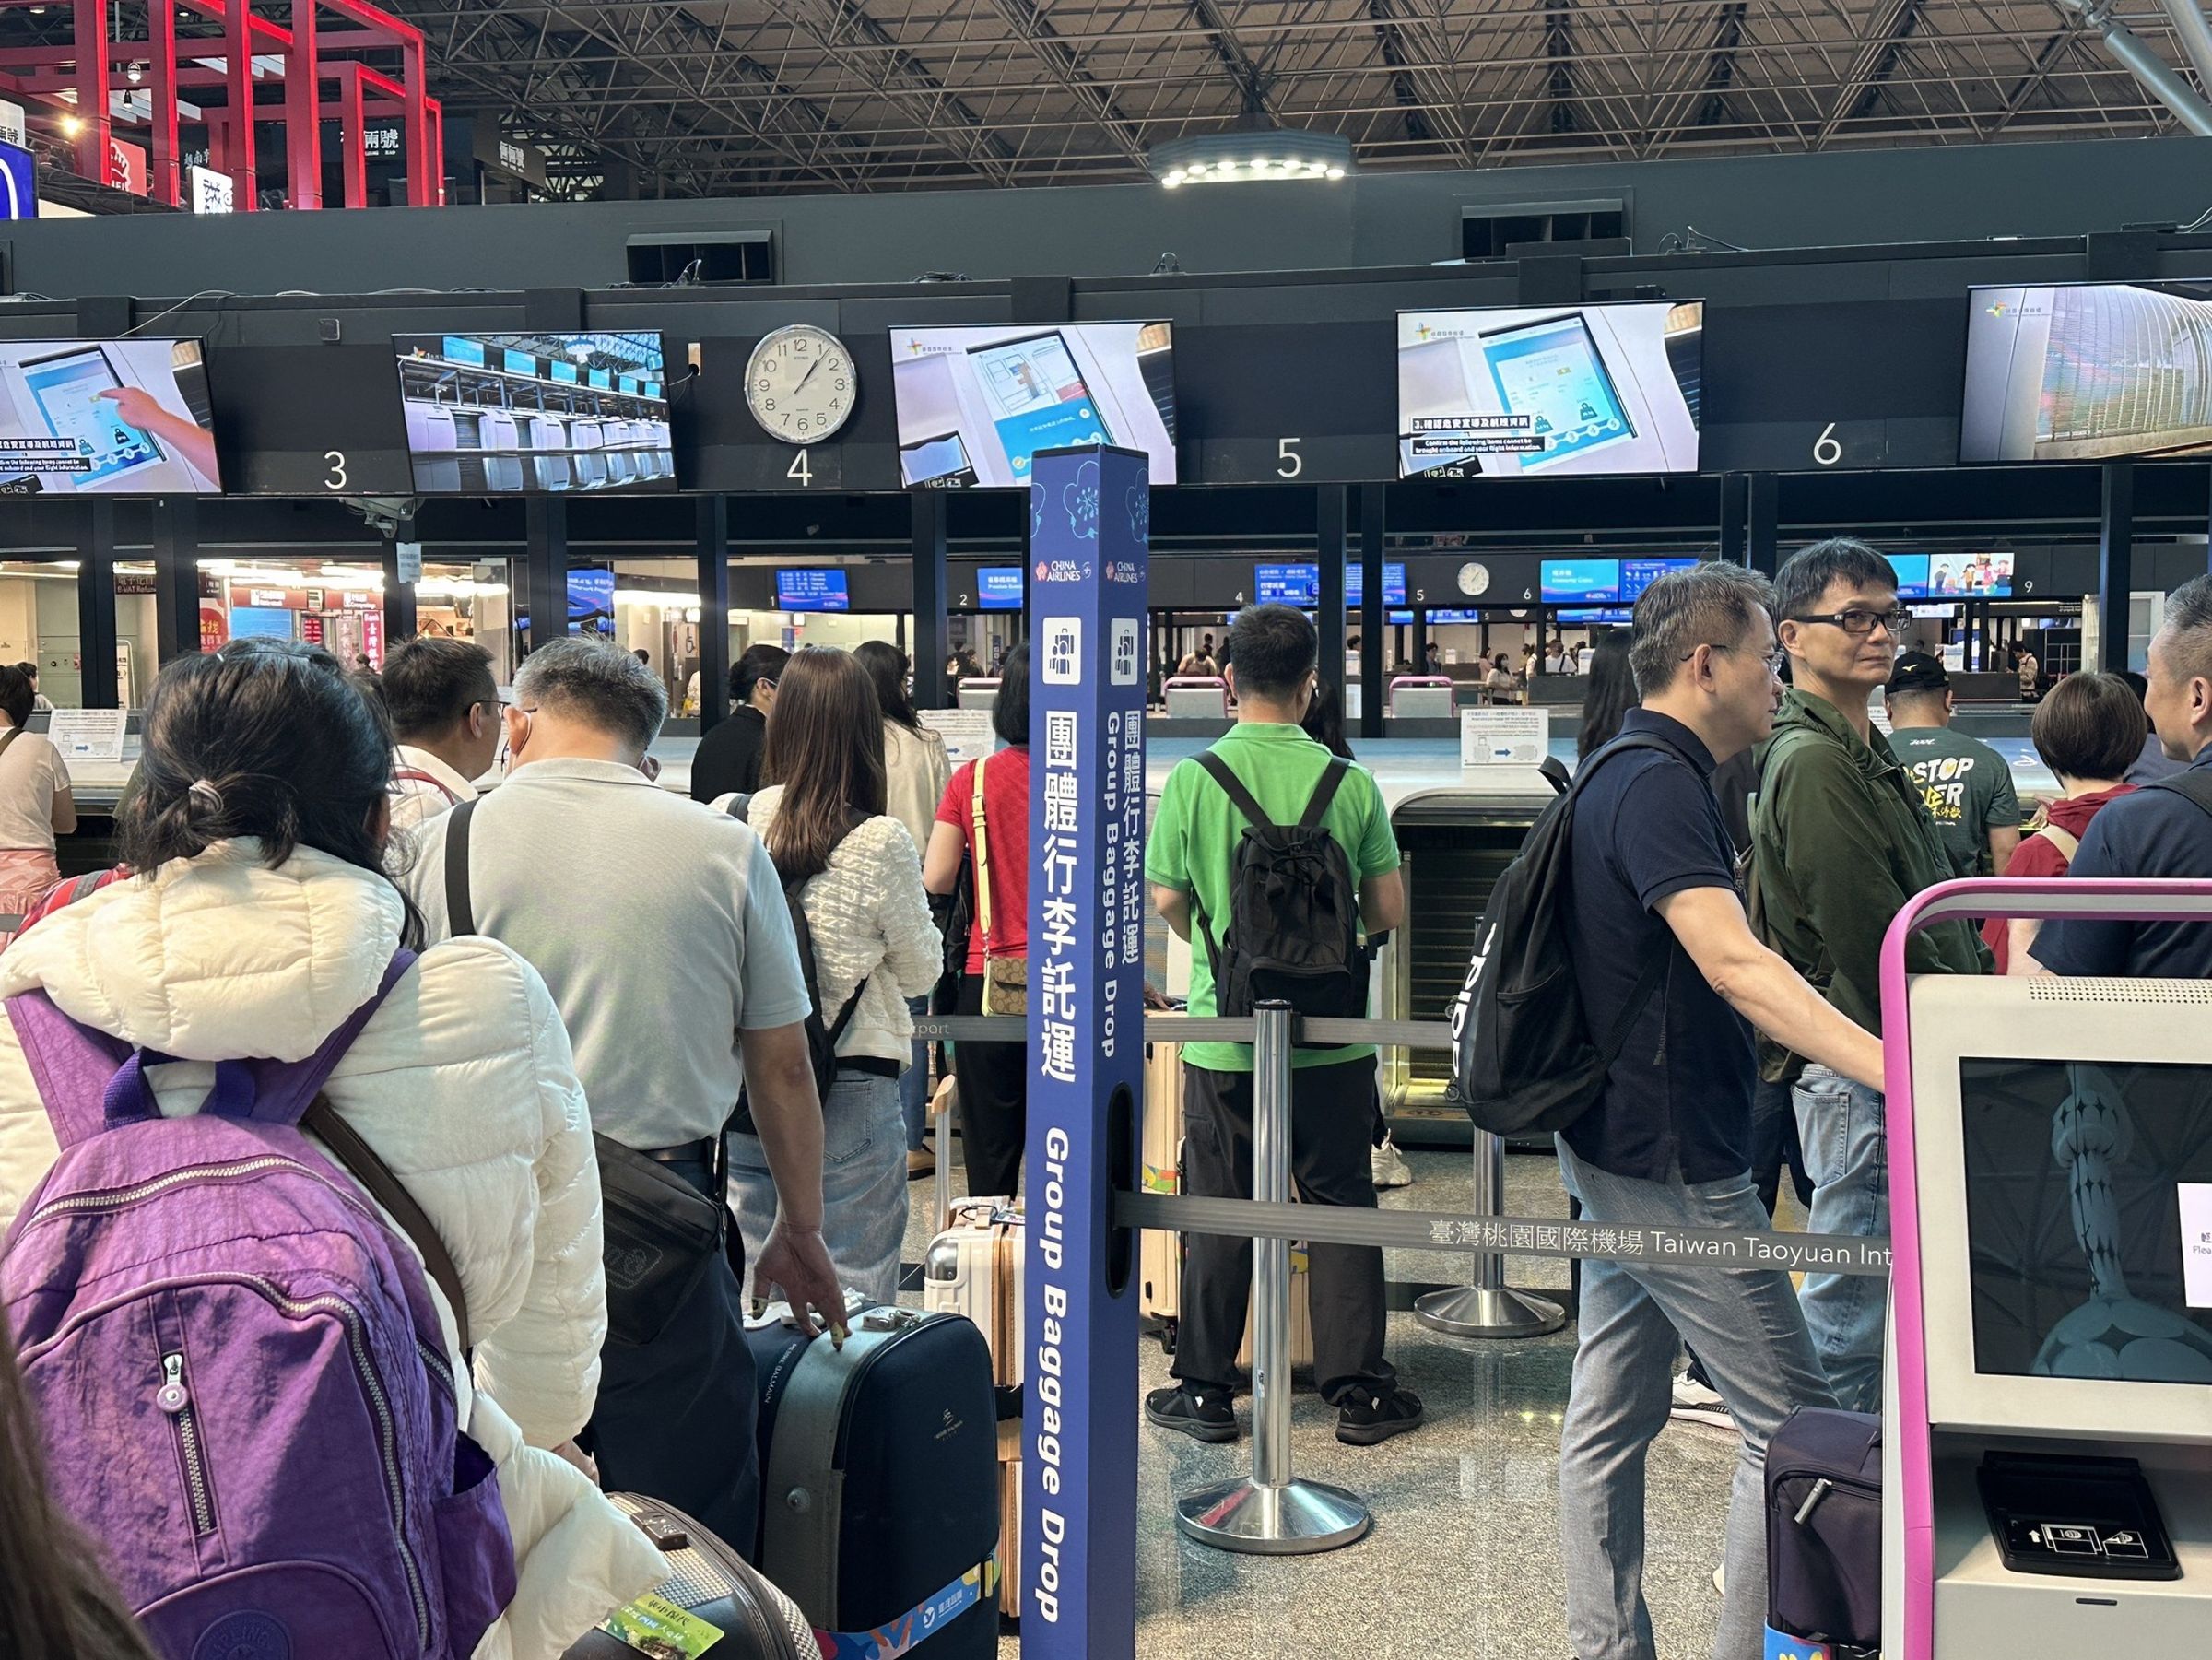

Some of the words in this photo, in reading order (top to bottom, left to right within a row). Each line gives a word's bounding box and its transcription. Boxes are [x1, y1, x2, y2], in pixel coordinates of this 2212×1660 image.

[777, 344, 787, 357] 11
[794, 339, 807, 352] 12
[818, 343, 822, 355] 1
[763, 359, 777, 372] 10
[829, 358, 839, 371] 2
[759, 379, 770, 391] 9
[834, 378, 845, 391] 3
[765, 398, 775, 411] 8
[829, 398, 840, 410] 4
[781, 413, 790, 426] 7
[797, 418, 808, 430] 6
[816, 413, 827, 425] 5
[1813, 422, 1841, 464] 6
[1277, 438, 1301, 478] 5
[324, 451, 347, 489] 3
[787, 449, 813, 487] 4
[1051, 561, 1076, 571] CHINA
[1117, 561, 1135, 571] CHINA
[1046, 571, 1081, 582] AIRLINES
[1114, 572, 1138, 583] AIRLINES
[2024, 581, 2033, 593] 9
[959, 594, 968, 606] 2
[1235, 592, 1243, 603] 4
[1417, 589, 1425, 601] 5
[1524, 588, 1532, 600] 6
[770, 595, 775, 607] 1
[1104, 712, 1121, 812] Group
[1912, 757, 1974, 783] STOP
[1122, 710, 1142, 965] 團體行李託運
[1041, 710, 1077, 1083] 團體行李託運
[1101, 822, 1119, 970] Baggage
[1101, 979, 1118, 1058] Drop
[1039, 1126, 1069, 1270] Group
[1429, 1219, 1644, 1255] 臺灣桃園國際機場
[1650, 1230, 1736, 1257] Taiwan
[1744, 1237, 1851, 1267] Taoyuan
[1038, 1283, 1067, 1496] Baggage
[1035, 1508, 1065, 1623] Drop
